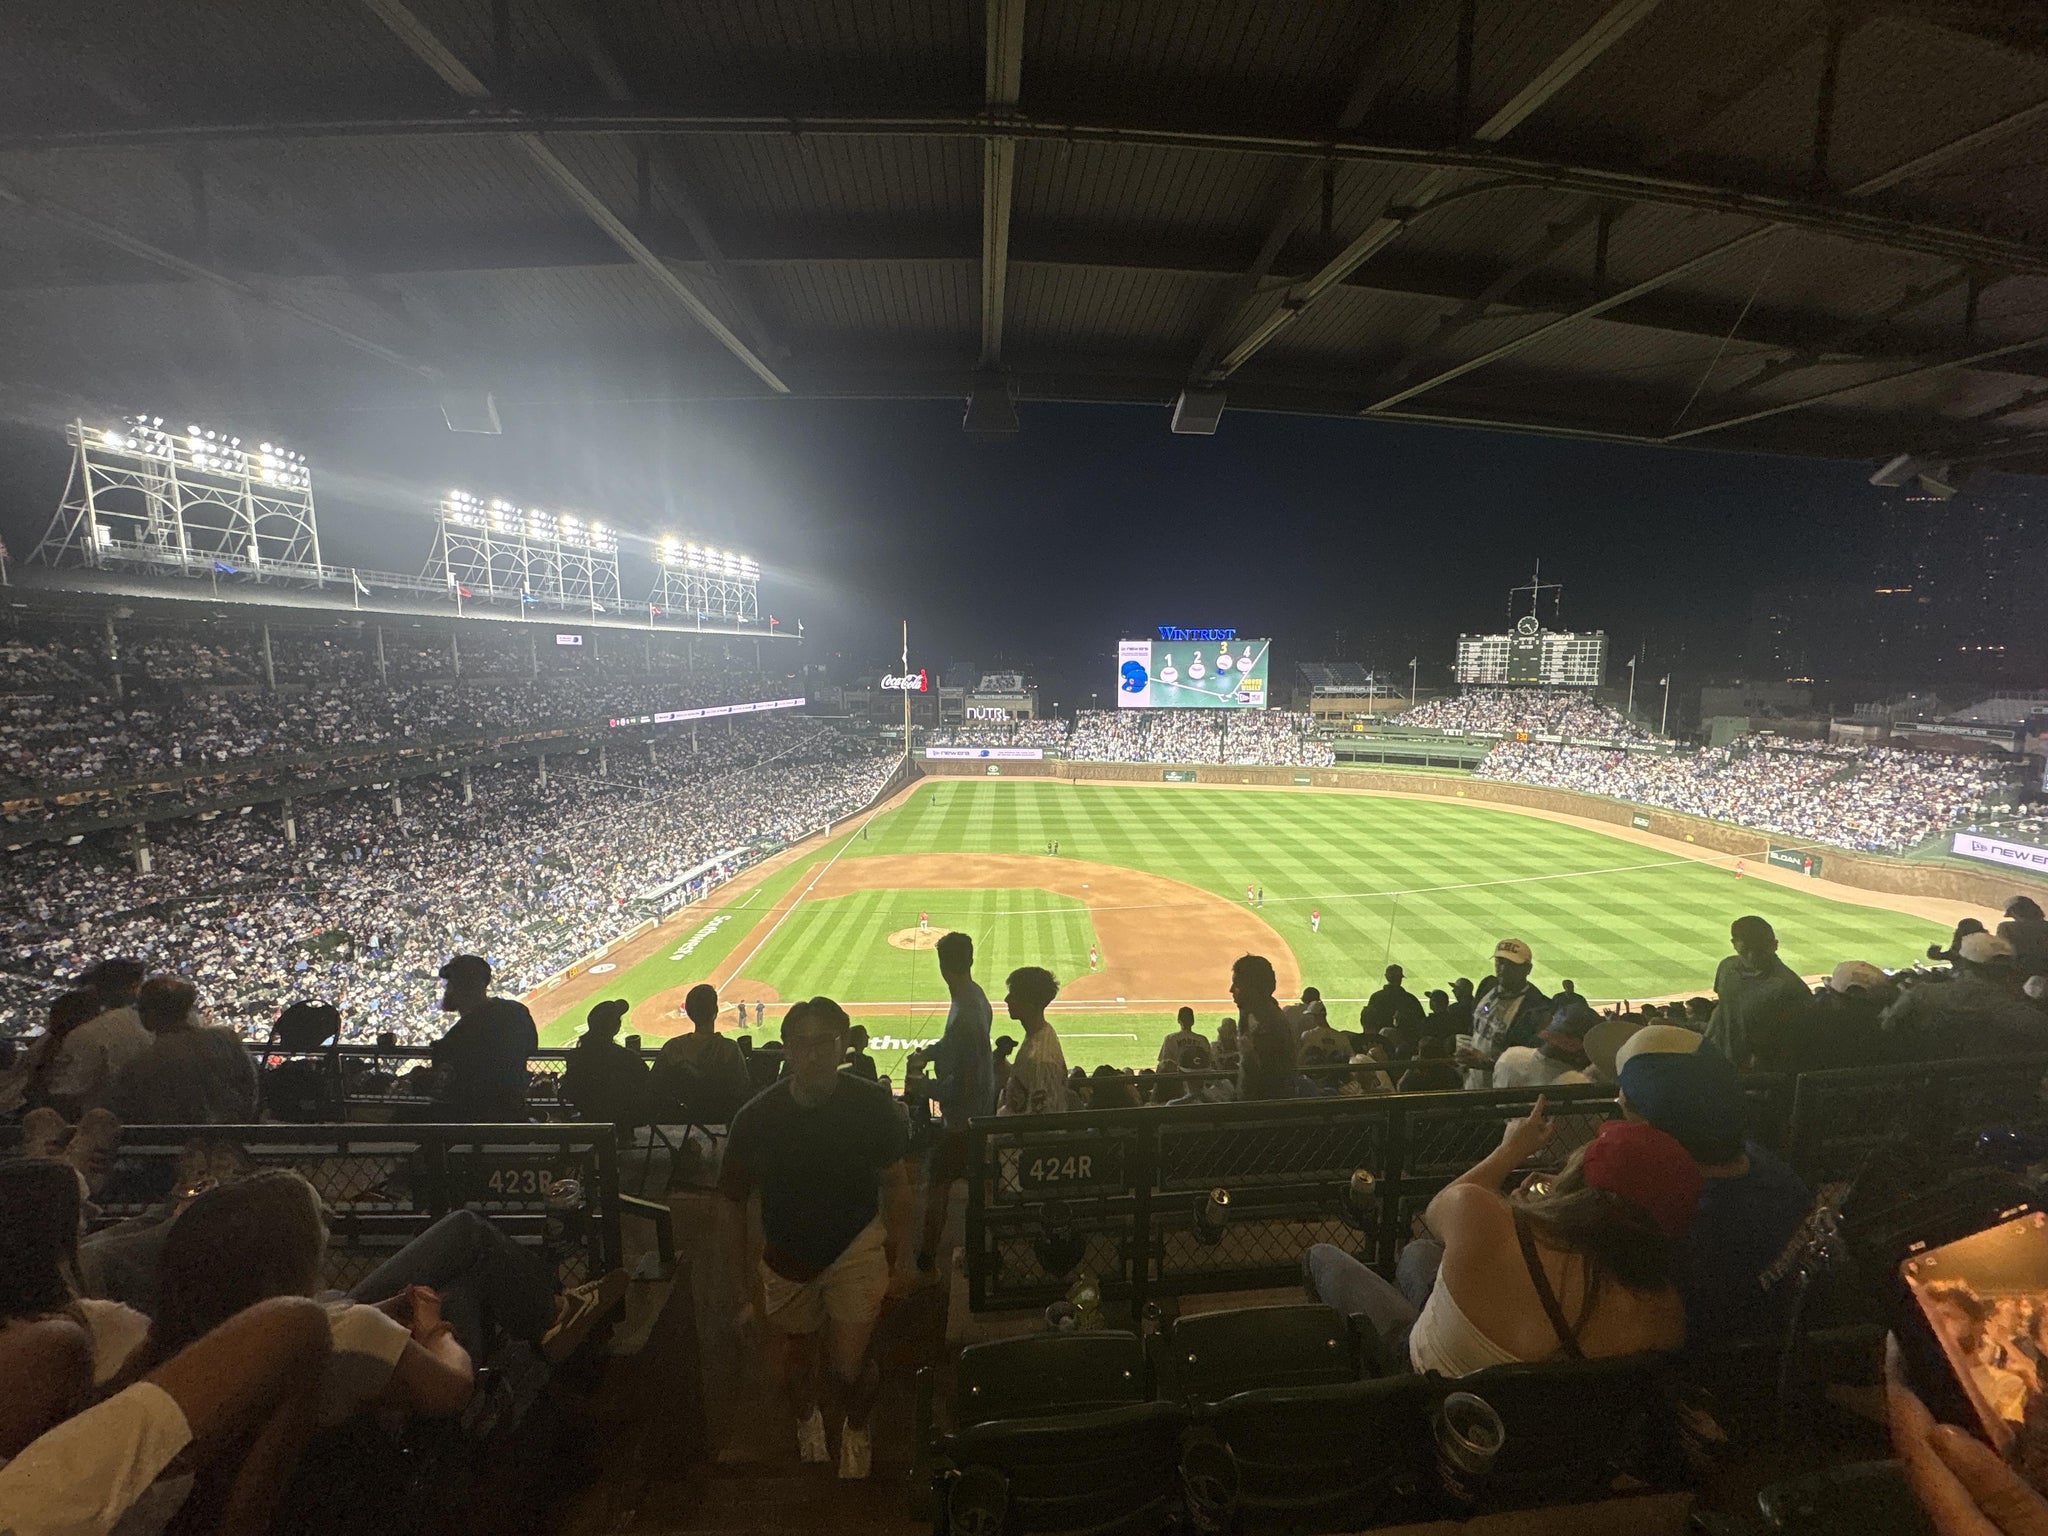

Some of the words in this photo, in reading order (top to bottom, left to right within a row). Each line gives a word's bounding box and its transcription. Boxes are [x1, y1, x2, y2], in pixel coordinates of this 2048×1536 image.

[1158, 626, 1237, 641] WINTRUST
[1220, 641, 1228, 655] 3
[1243, 645, 1251, 657] 4
[1164, 653, 1172, 667] 1
[1193, 650, 1202, 664] 2
[1442, 728, 1464, 736] YETI
[1627, 742, 1657, 751] Advocate
[1028, 1155, 1092, 1182] 424R
